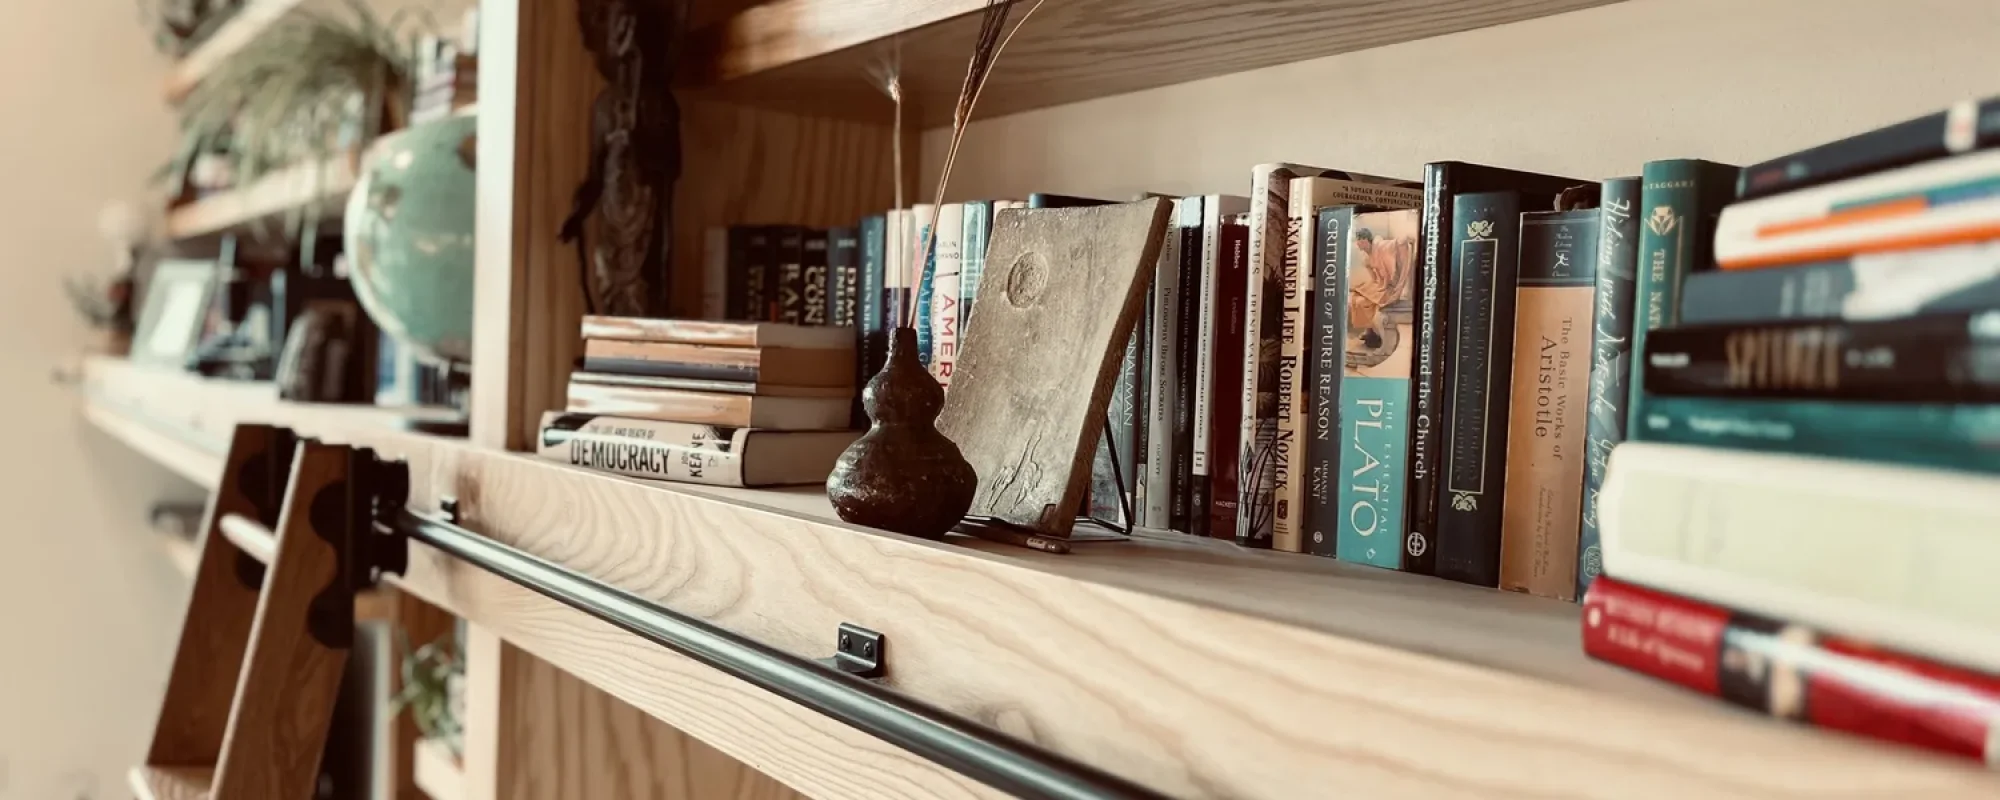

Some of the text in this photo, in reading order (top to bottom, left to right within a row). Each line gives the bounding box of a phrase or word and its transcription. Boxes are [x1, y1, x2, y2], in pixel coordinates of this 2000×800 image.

[1233, 239, 1241, 269] Hobbes
[1252, 187, 1265, 276] PAPYRUS
[1284, 215, 1303, 300] EXAMINED
[1322, 218, 1339, 298] CRITIQUE
[1600, 197, 1631, 266] Hiking
[1652, 248, 1666, 282] THE
[919, 315, 930, 345] THE
[1230, 296, 1238, 335] Leviathan
[1249, 293, 1257, 337] IRENE
[1283, 304, 1300, 344] LIFE
[1422, 276, 1437, 338] Science
[1158, 287, 1172, 422] PHILOSOPHY BEFORE SOCRATES
[1320, 323, 1334, 369] PURE
[1419, 344, 1432, 376] and
[1122, 383, 1134, 426] MAN
[1278, 354, 1297, 424] ROBERT
[1317, 374, 1331, 441] REASON
[1418, 381, 1431, 409] the
[1535, 335, 1557, 438] Aristotle
[1552, 317, 1573, 461] The Basic Works of
[571, 439, 671, 475] DEMOCRACY
[689, 433, 706, 478] KEANE
[1276, 428, 1294, 491] NOZICK
[1351, 399, 1384, 537] PLATO
[1380, 401, 1394, 534] THE ESSENTIAL
[1415, 414, 1430, 480] Church
[1312, 467, 1322, 498] KANT
[1320, 459, 1329, 505] IMMANUEL
